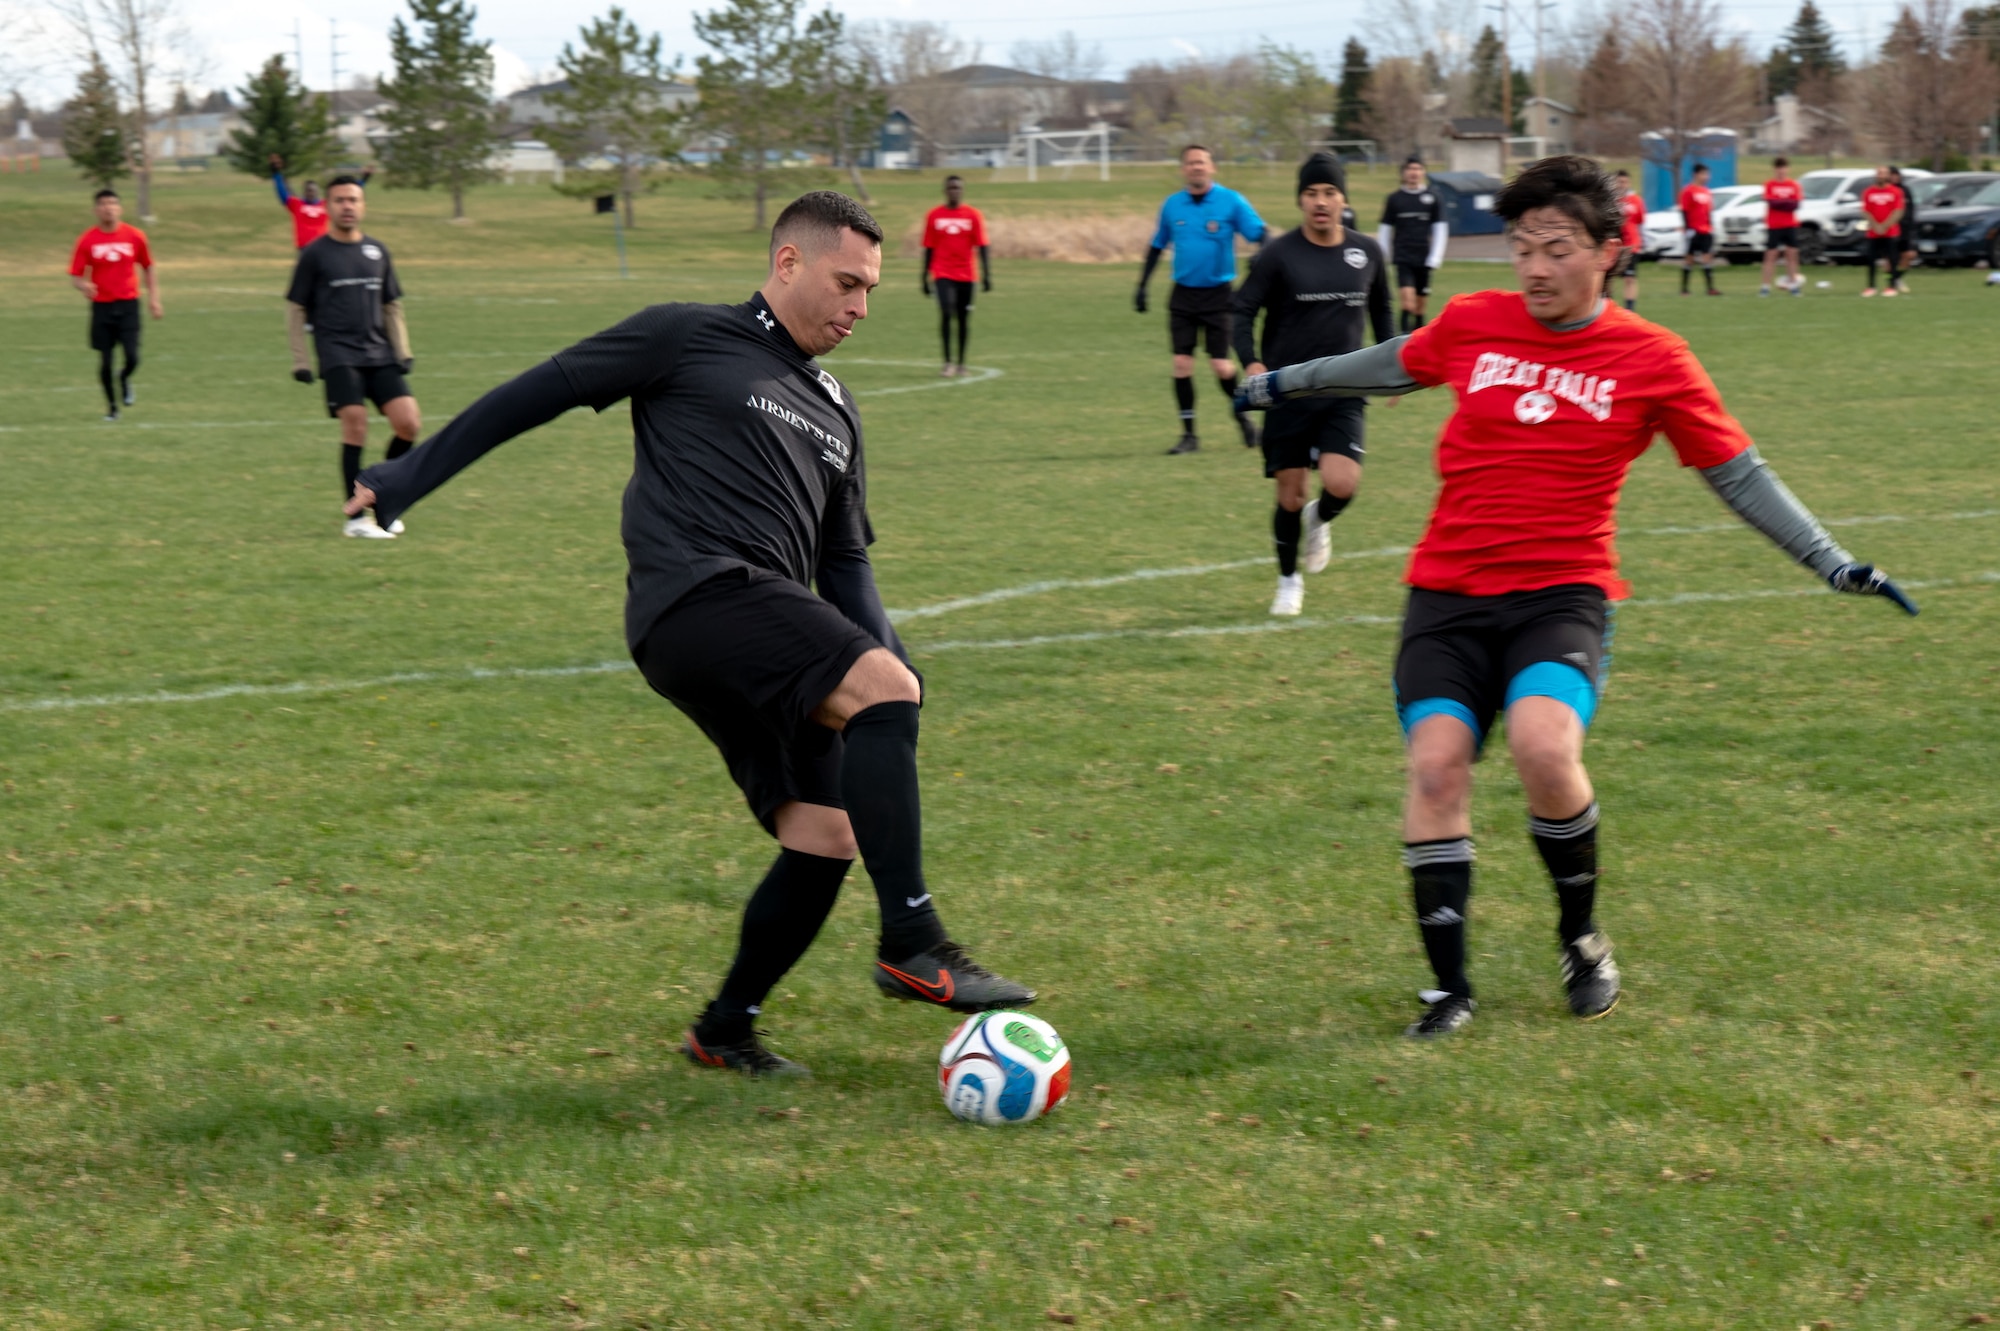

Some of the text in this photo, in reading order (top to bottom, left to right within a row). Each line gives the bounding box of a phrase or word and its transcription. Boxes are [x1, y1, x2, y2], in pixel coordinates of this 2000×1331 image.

[1466, 351, 1617, 422] GREAT FALLS
[746, 394, 850, 457] AIRMEN'S CUP
